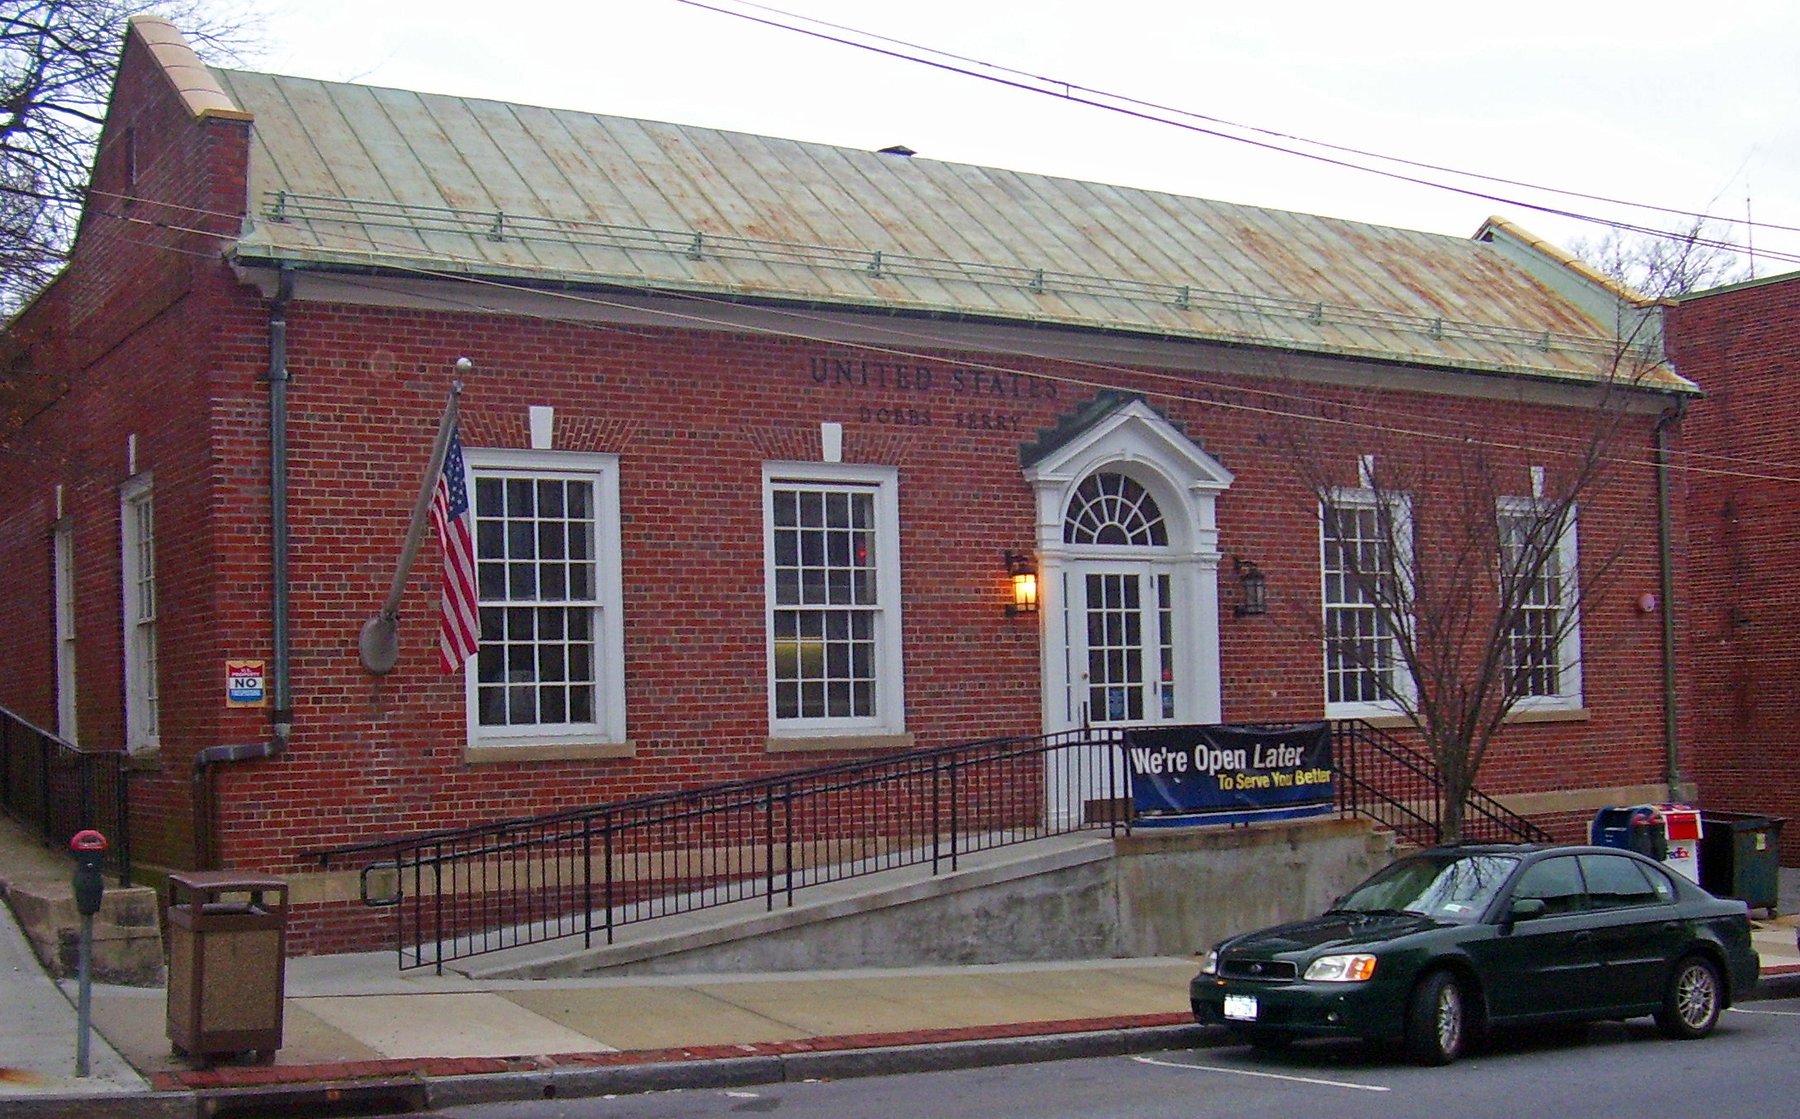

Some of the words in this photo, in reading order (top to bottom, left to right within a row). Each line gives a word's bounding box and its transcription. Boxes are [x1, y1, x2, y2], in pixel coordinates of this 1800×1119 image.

[811, 357, 932, 391] UNITED
[953, 368, 1058, 398] STATES
[859, 406, 933, 426] DOBBS
[956, 412, 1022, 431] FERRY
[235, 678, 257, 688] NO
[1130, 747, 1188, 775] We're
[1194, 744, 1247, 776] Open
[1253, 743, 1304, 768] Later
[1218, 773, 1233, 790] To
[1236, 774, 1270, 790] Serve
[1271, 771, 1293, 787] You
[1295, 768, 1332, 784] Better
